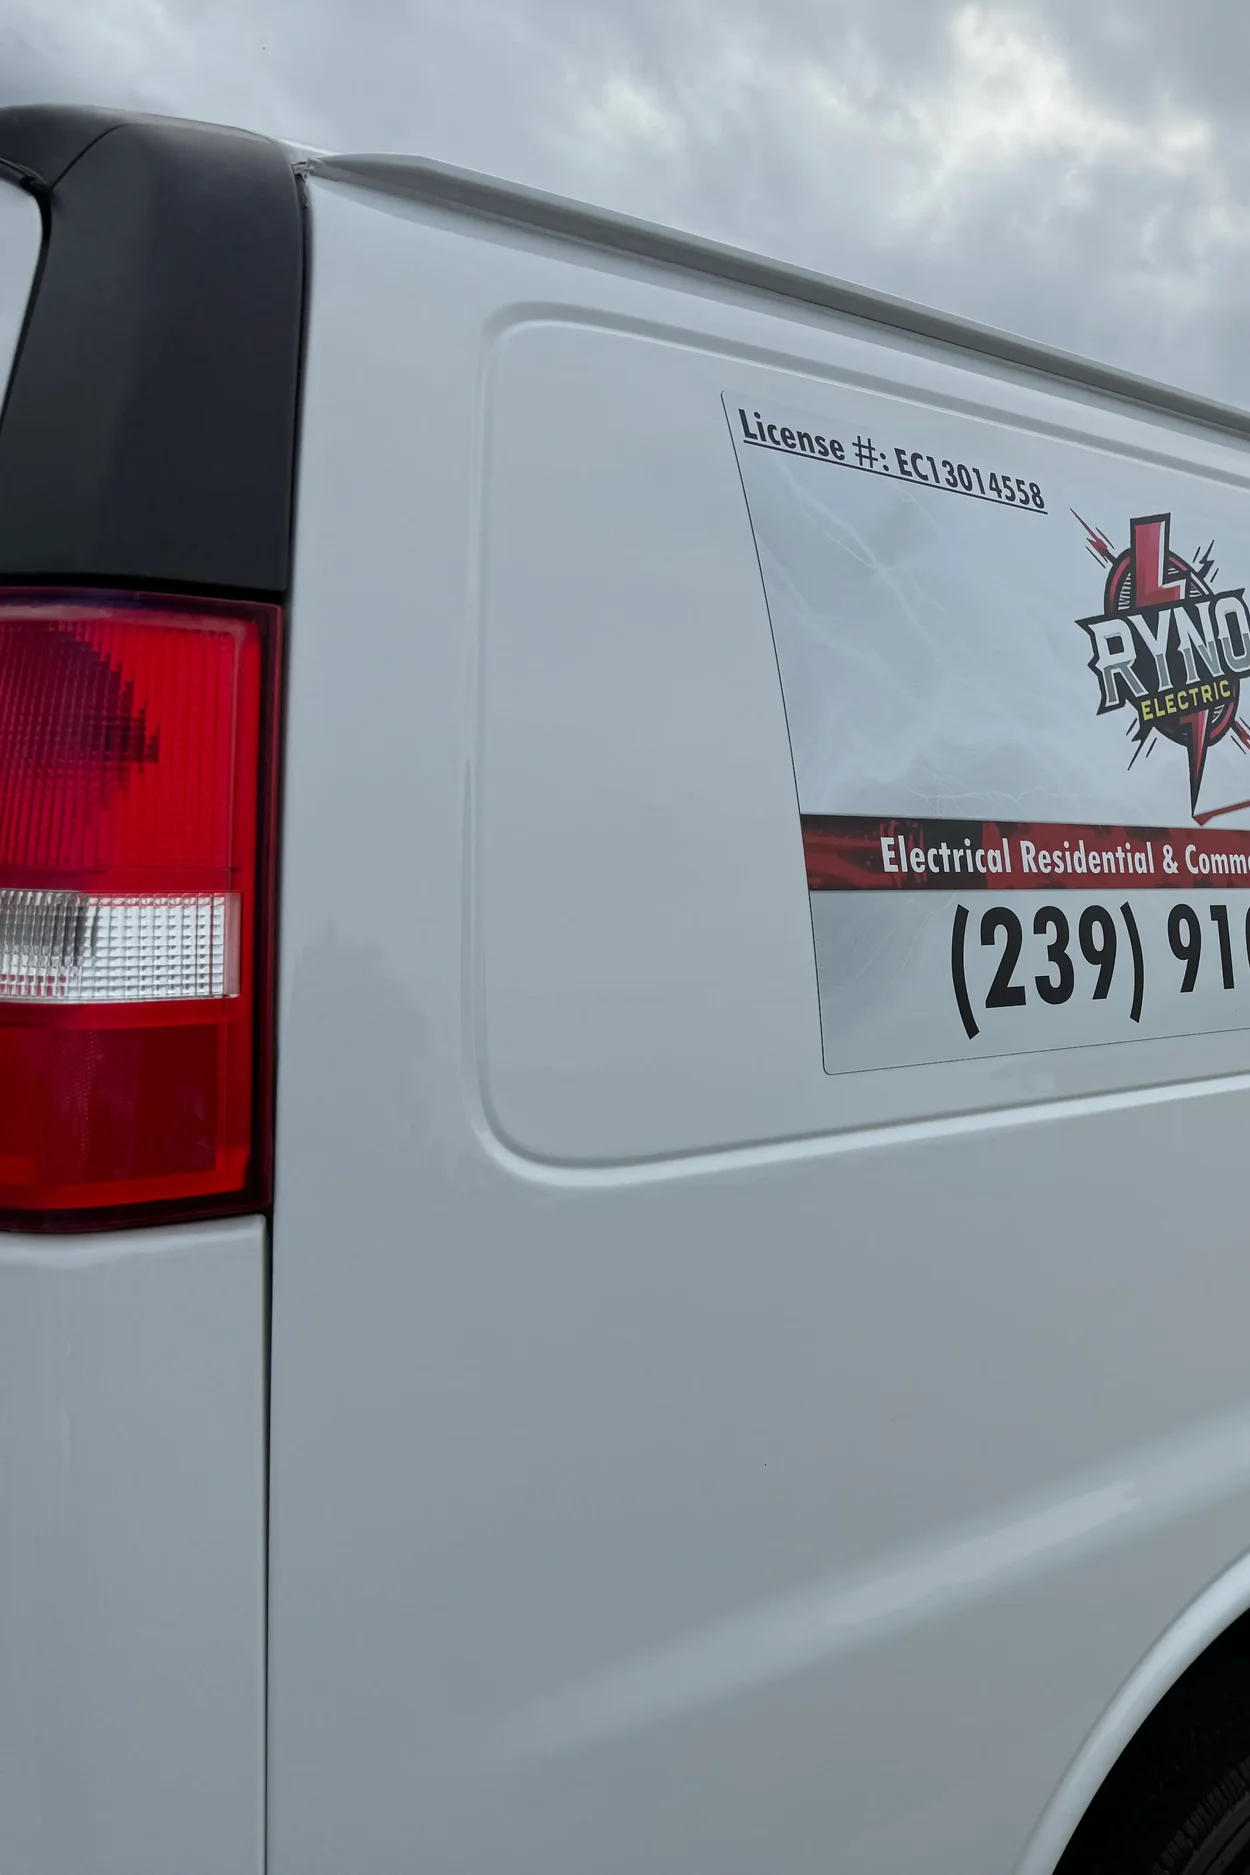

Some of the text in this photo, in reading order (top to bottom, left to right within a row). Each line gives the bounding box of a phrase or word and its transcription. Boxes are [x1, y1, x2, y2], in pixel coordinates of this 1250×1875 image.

[738, 408, 1046, 509] License #: EC13014558
[1087, 596, 1250, 708] RYNO
[1140, 679, 1232, 721] ELECTRIC
[880, 835, 1012, 874] Electrical
[1019, 839, 1155, 875] Residential
[1162, 844, 1179, 874] &
[950, 901, 1145, 1040] (239)
